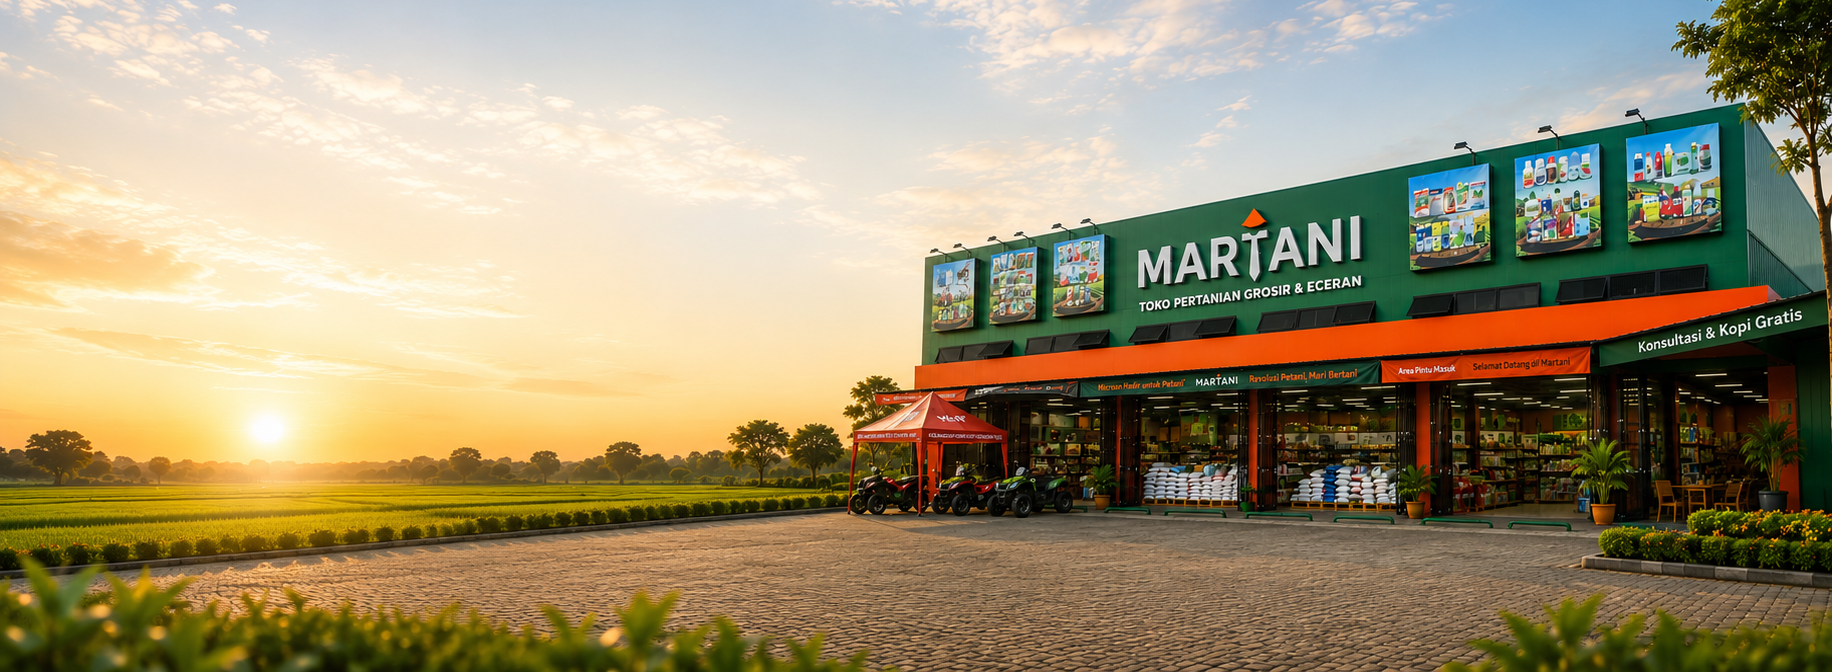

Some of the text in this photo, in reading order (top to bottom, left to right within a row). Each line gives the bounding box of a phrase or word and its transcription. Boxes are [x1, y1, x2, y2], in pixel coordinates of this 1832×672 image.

[1138, 215, 1363, 288] MARTANI
[1139, 275, 1362, 312] TOKO PERTANIAN GROSIR & ECERAN
[1638, 308, 1803, 353] Konsultasi & Kopi Gratis
[1328, 368, 1358, 379] Bertani
[1473, 362, 1502, 371] Selamat
[1503, 361, 1531, 370] Datang
[1541, 357, 1571, 367] Martani
[1195, 375, 1239, 387] MARTANI
